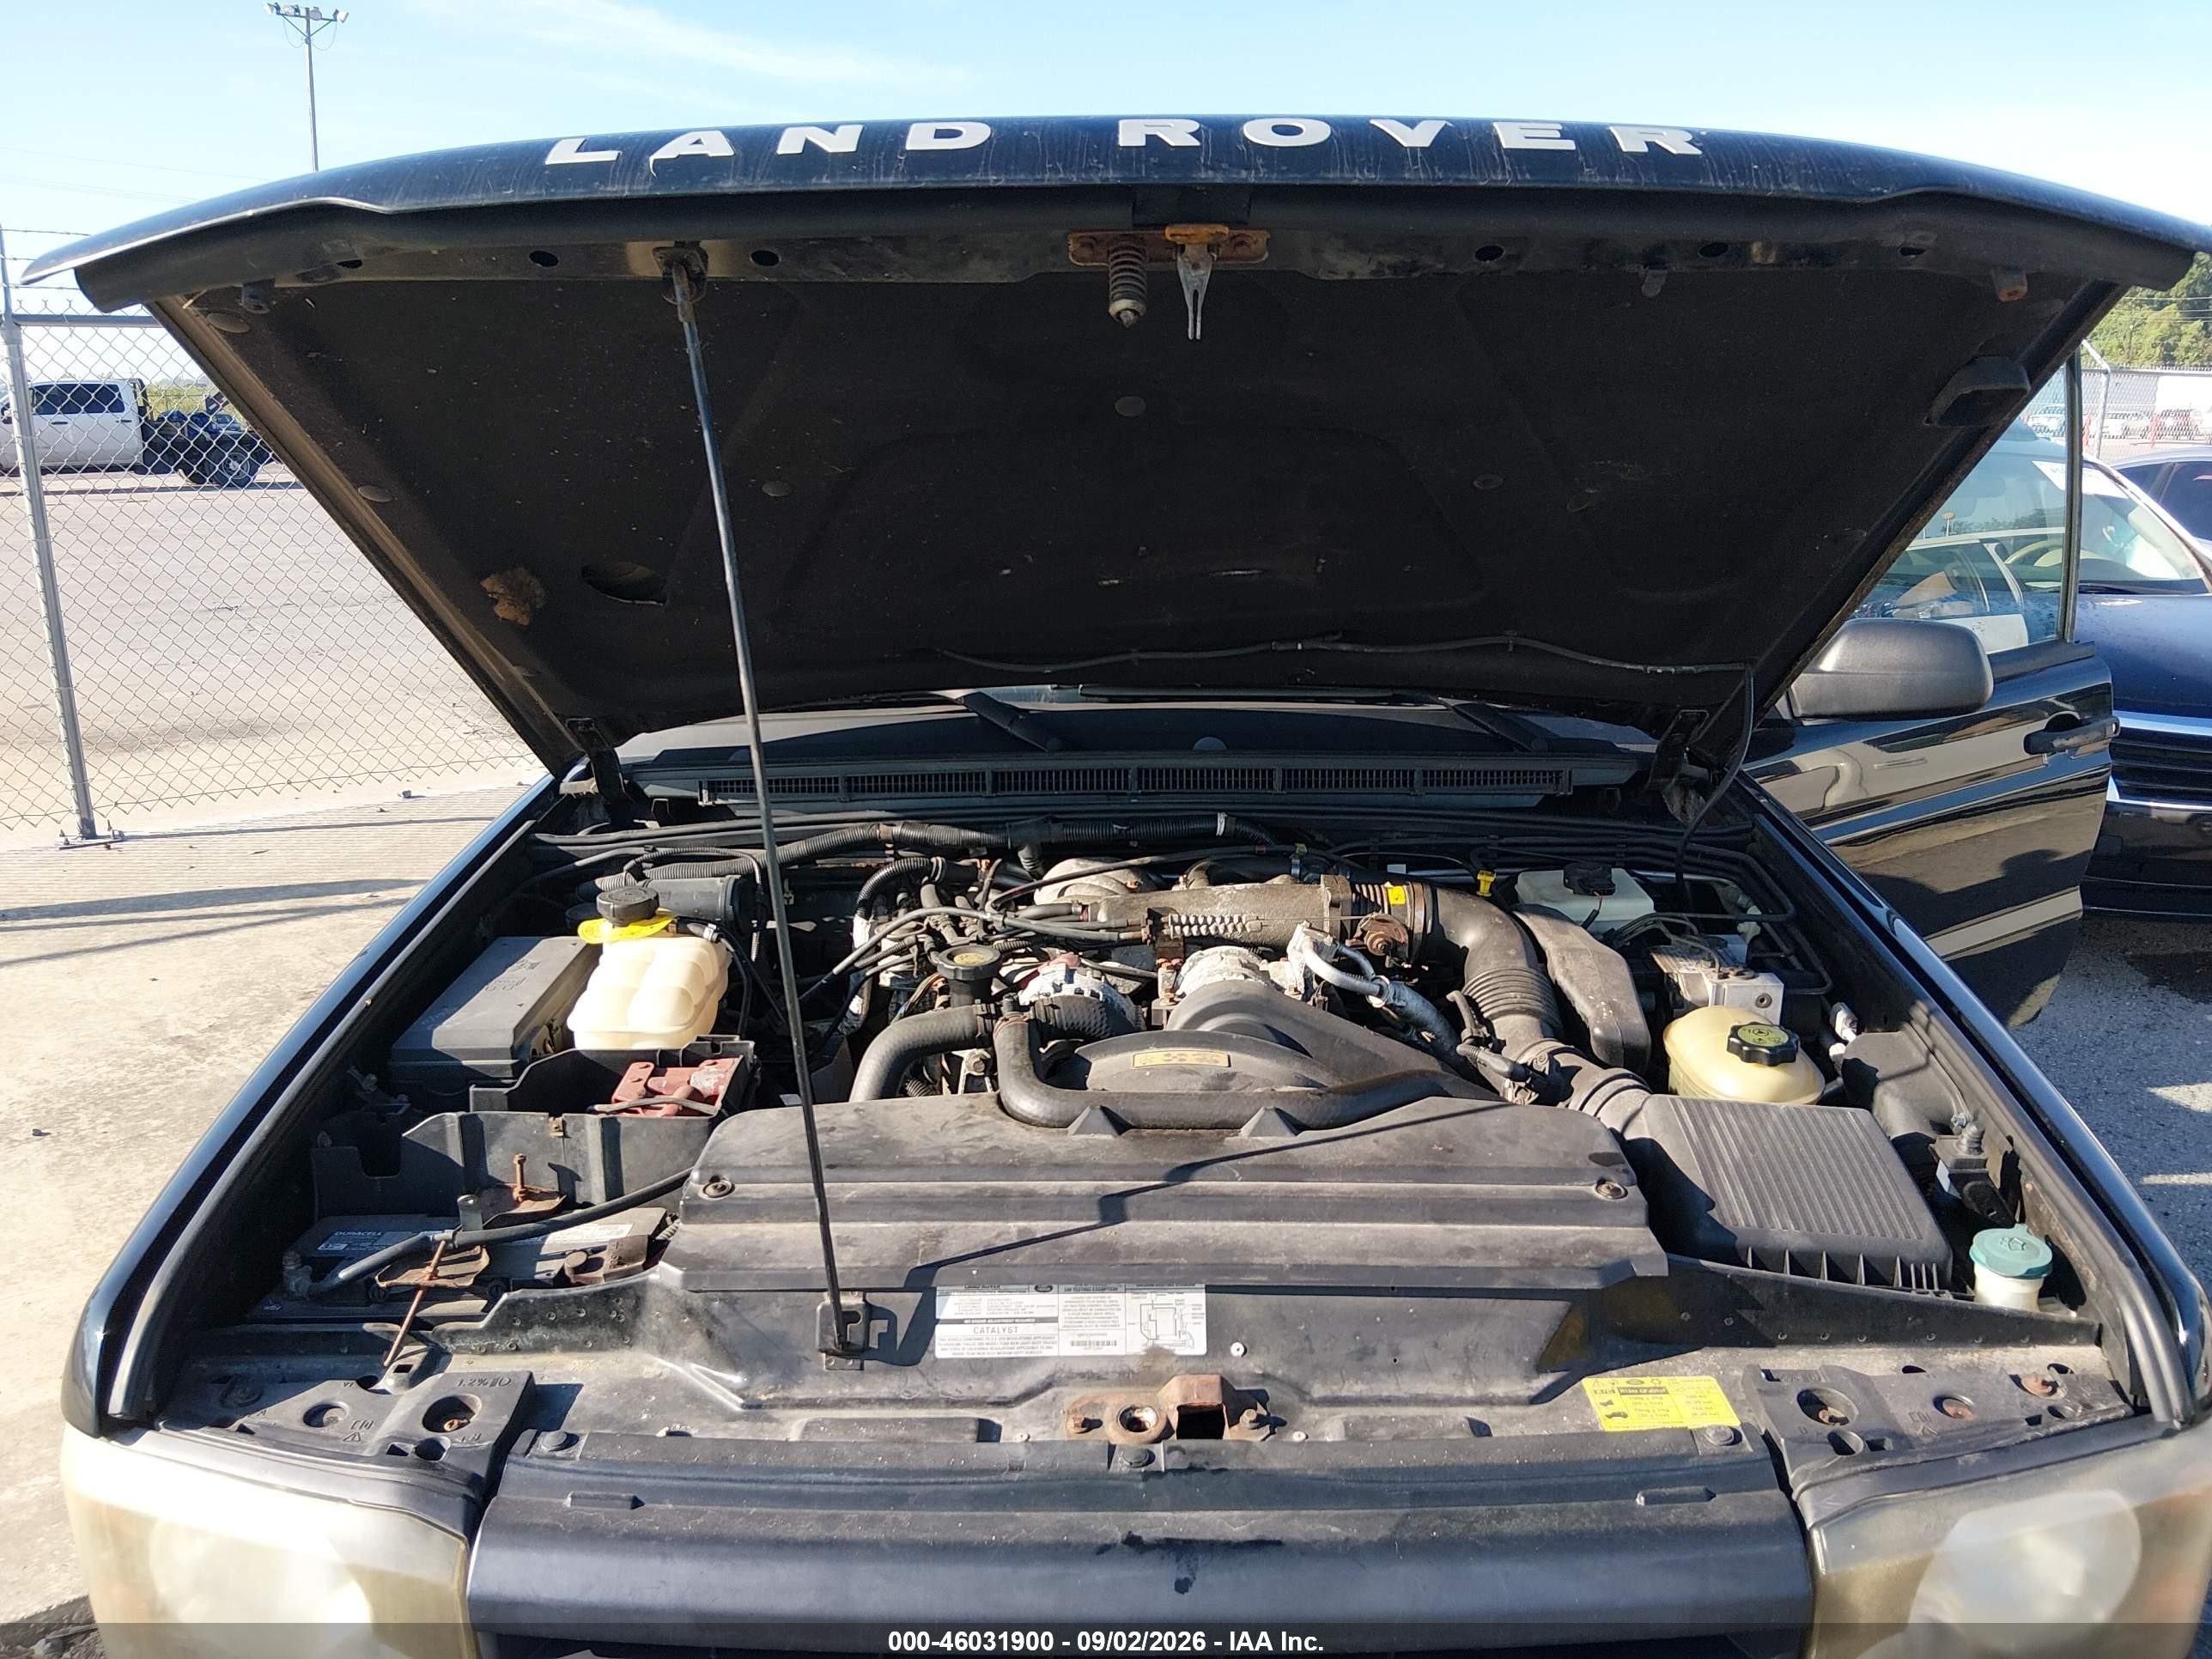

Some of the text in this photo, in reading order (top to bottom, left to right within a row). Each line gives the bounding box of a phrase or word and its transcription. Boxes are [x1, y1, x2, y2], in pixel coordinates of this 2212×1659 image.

[545, 117, 1703, 166] LAND ROVER
[973, 1326, 1018, 1334] CATALYST
